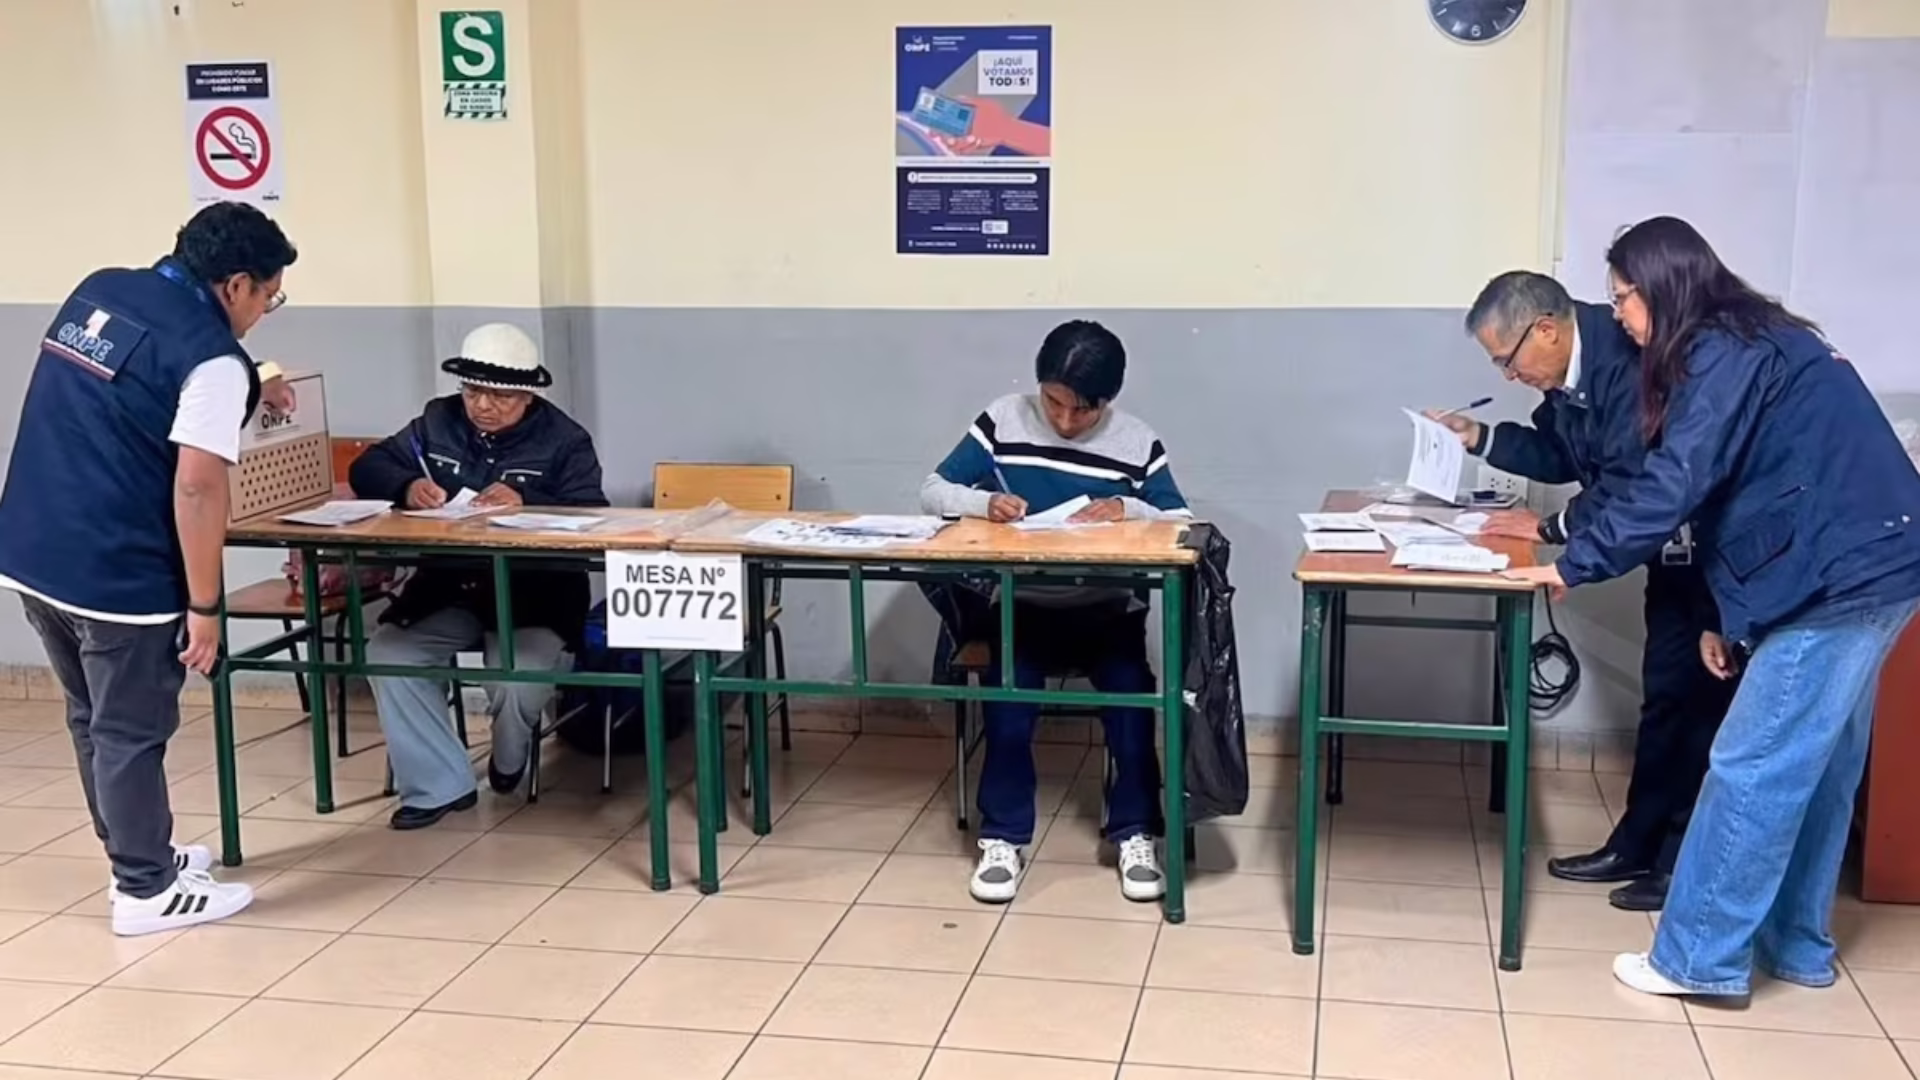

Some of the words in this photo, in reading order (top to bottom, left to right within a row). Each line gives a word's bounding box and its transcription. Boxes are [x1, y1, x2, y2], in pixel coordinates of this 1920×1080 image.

[1471, 25, 1481, 37] 6
[452, 16, 495, 77] S
[983, 67, 1034, 76] VOTAMOS
[57, 322, 114, 362] ONPE
[626, 564, 693, 585] MESA
[611, 587, 737, 620] 007772
